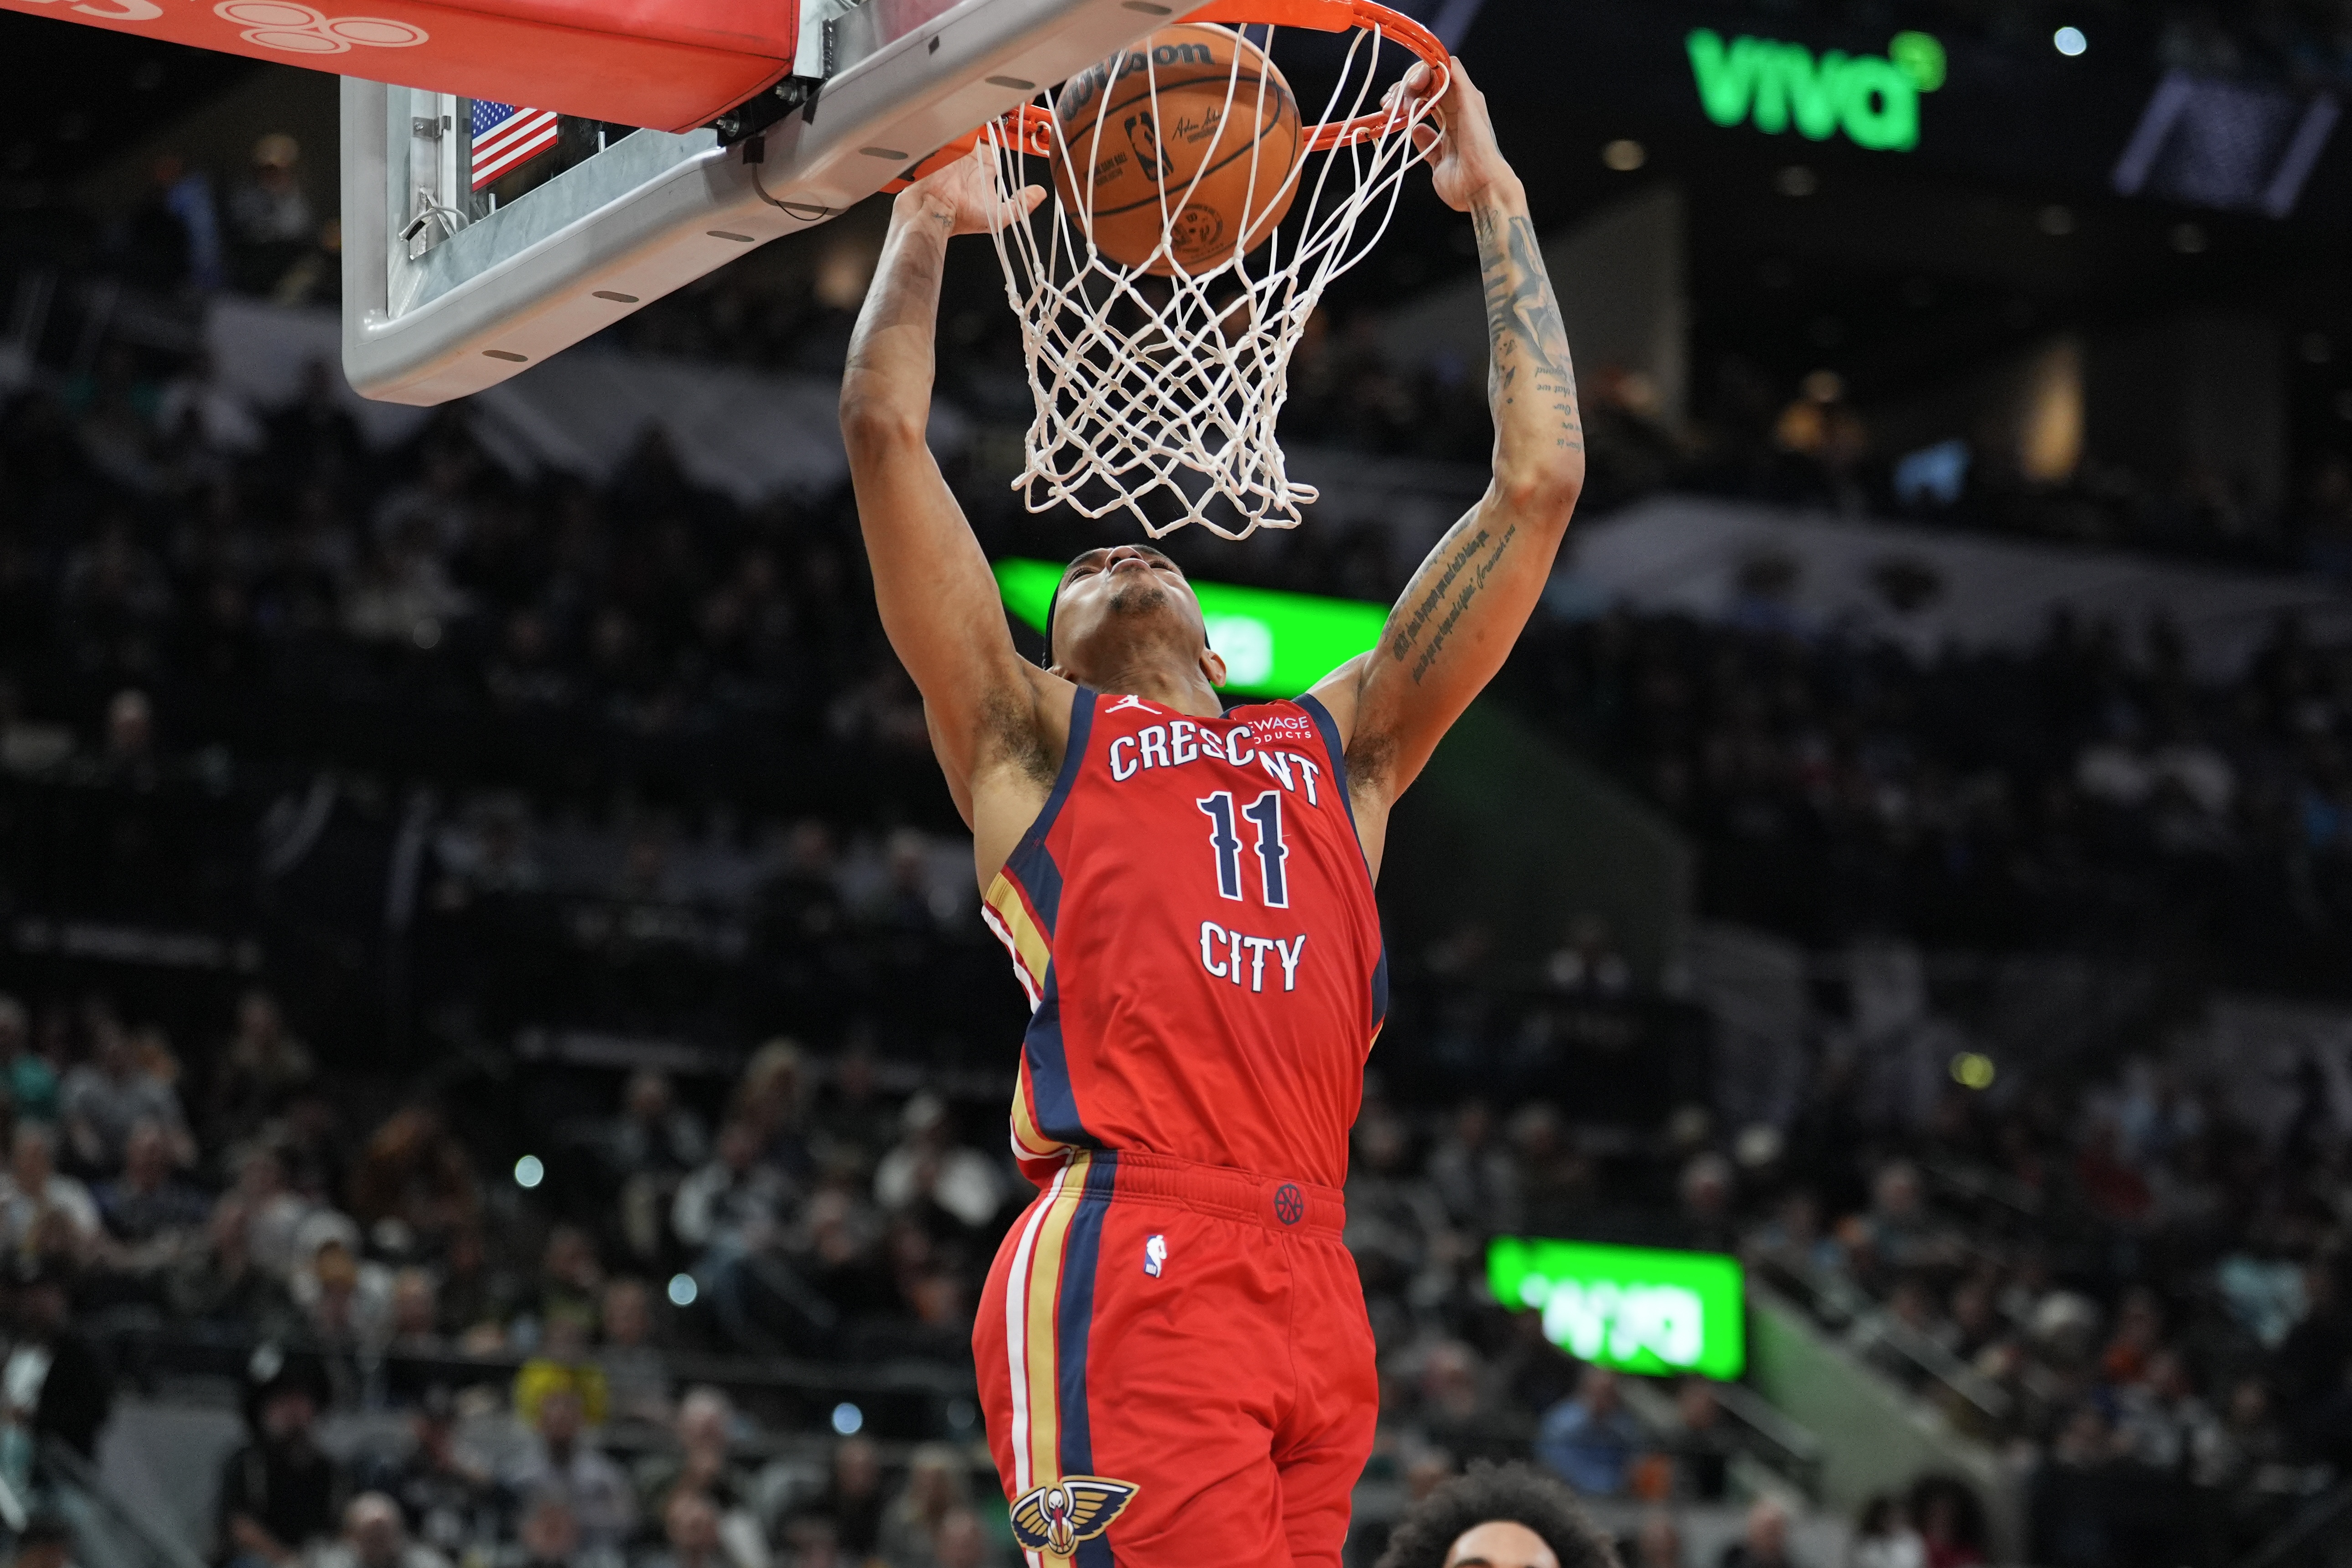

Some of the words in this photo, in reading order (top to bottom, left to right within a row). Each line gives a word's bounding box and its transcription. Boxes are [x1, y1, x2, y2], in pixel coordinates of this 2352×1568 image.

[1248, 716, 1309, 734] WAGE
[1254, 731, 1312, 745] ODUCTS
[1109, 719, 1320, 808] CRESCNT
[1196, 790, 1289, 909] 11
[1200, 920, 1306, 993] CITY
